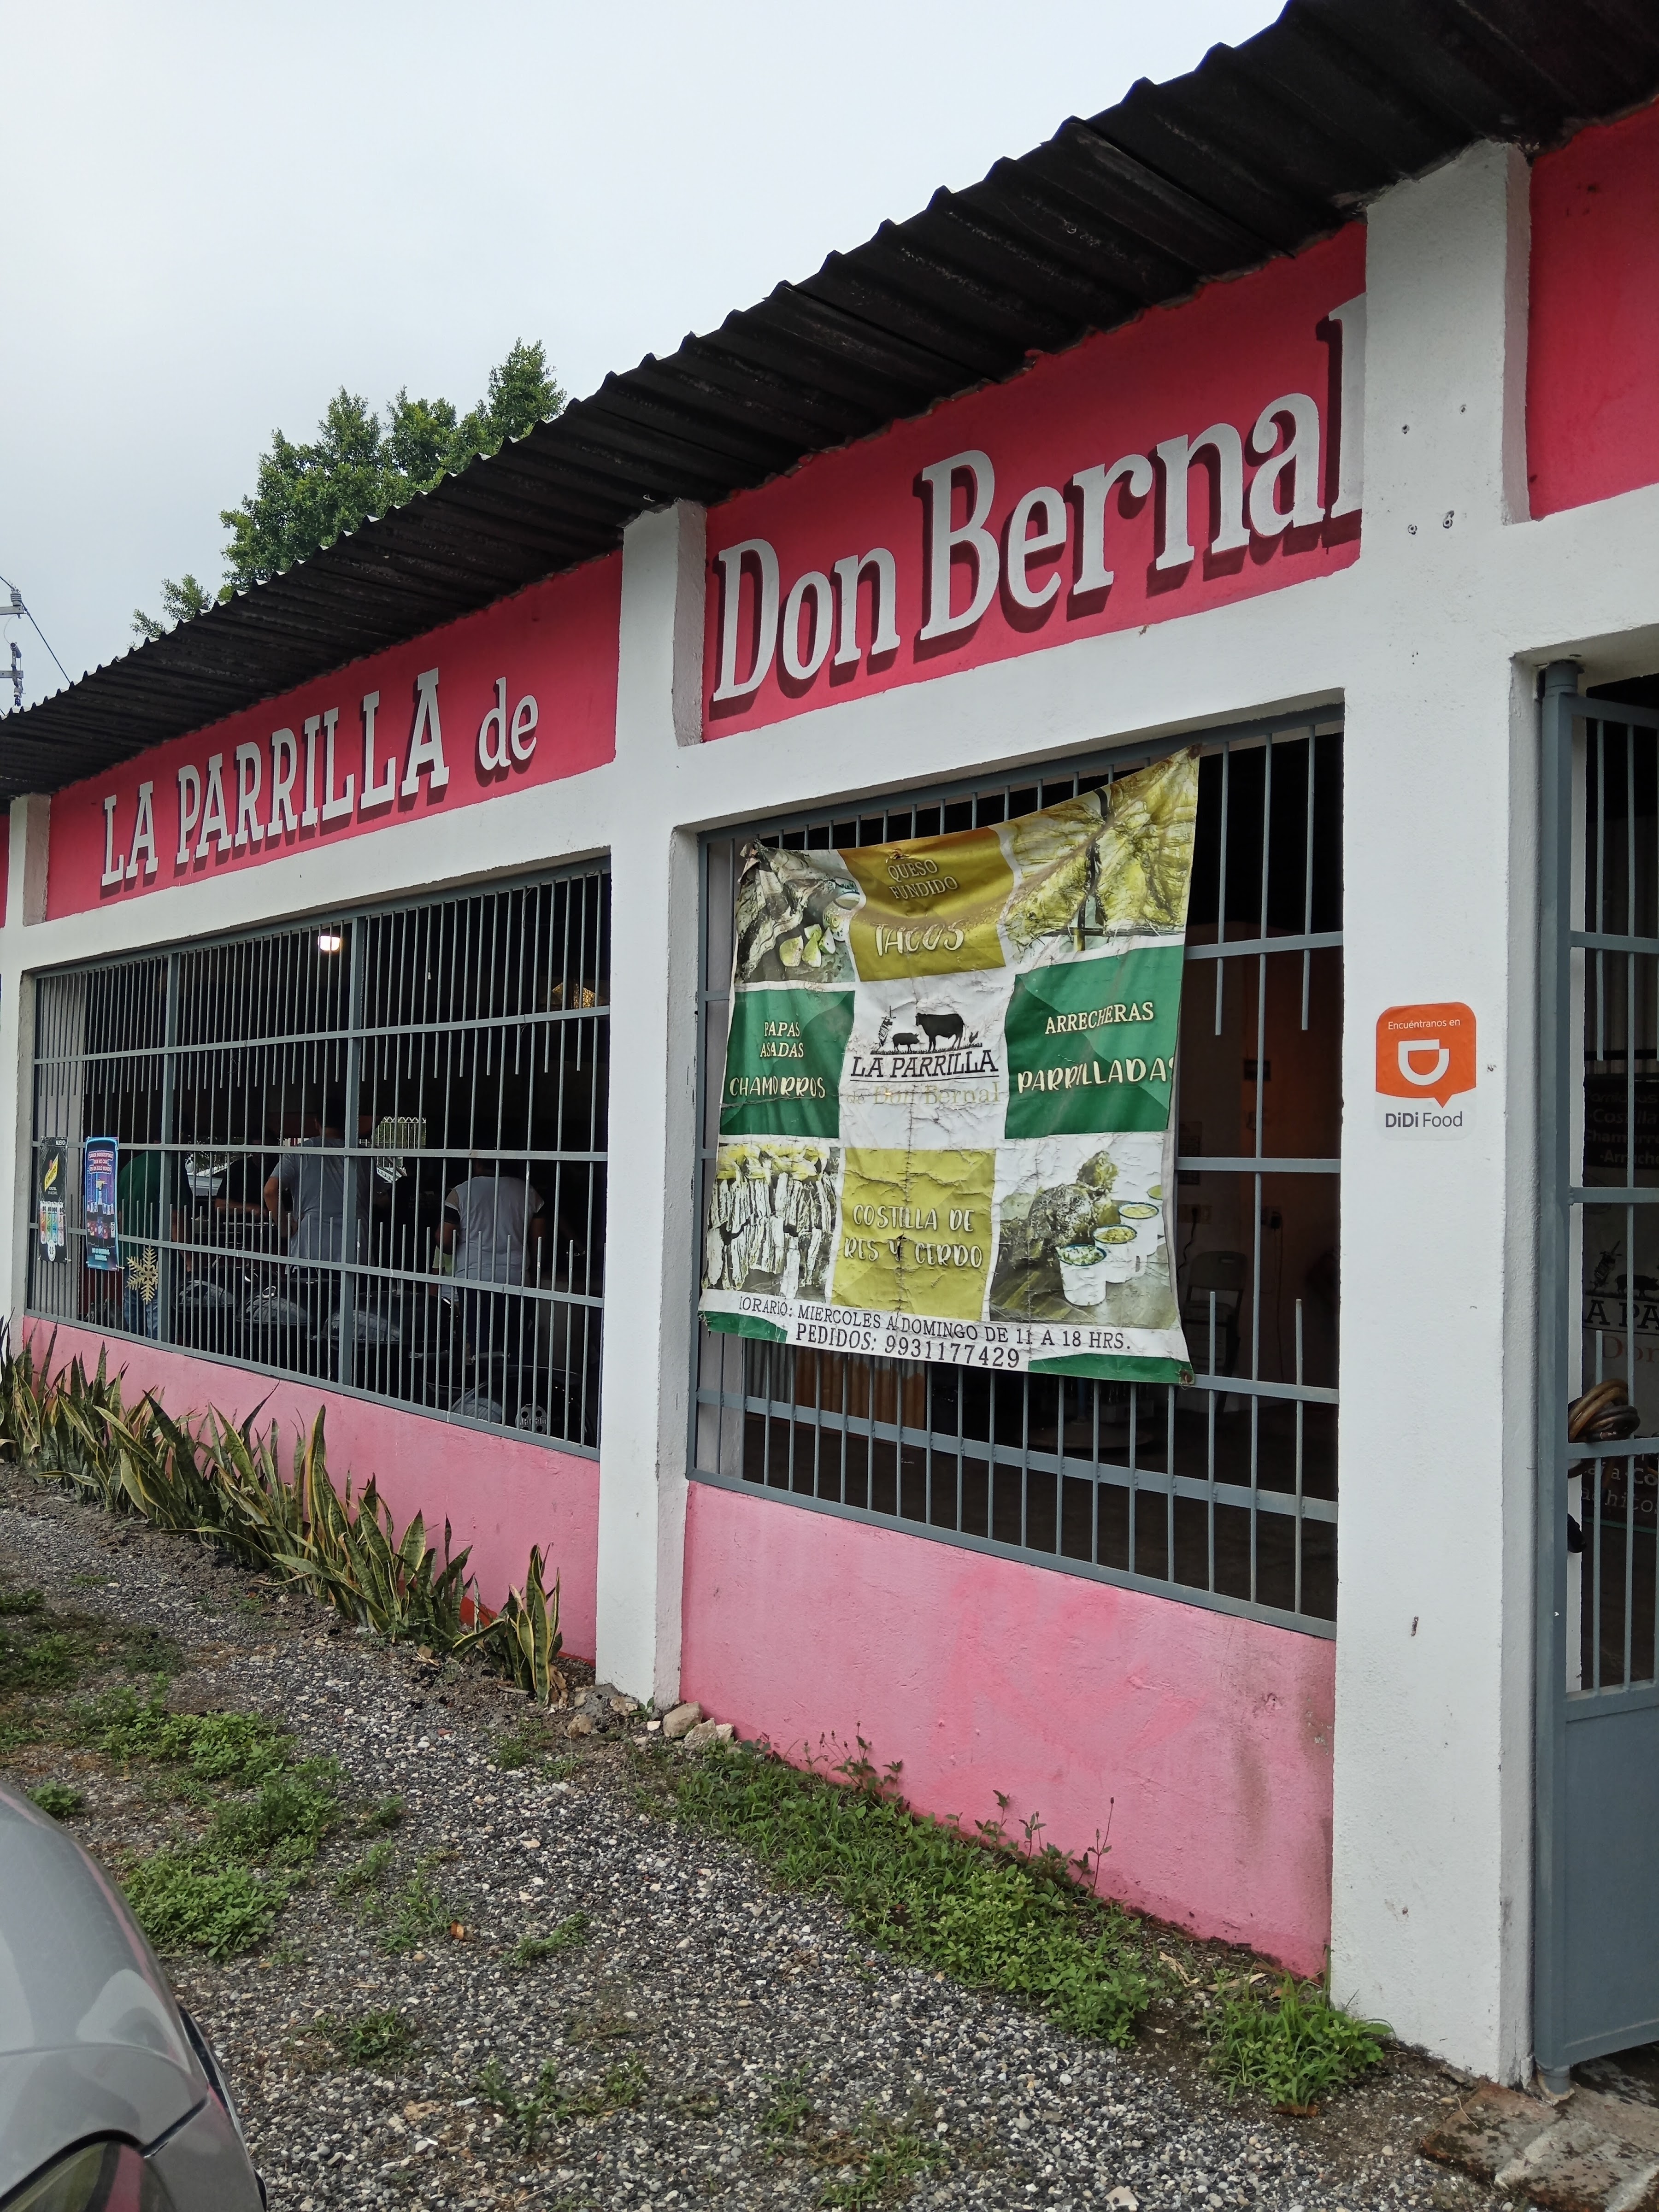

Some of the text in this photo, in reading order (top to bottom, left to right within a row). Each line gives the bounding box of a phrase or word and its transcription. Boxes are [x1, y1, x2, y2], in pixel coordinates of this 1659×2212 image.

[713, 292, 1367, 702] Don Bernal
[101, 667, 539, 887] LA PARRILLA de
[888, 859, 938, 883] QUESO
[889, 876, 959, 900] FUNDIDO
[872, 921, 965, 957] TACOS
[764, 1021, 800, 1037] PAPAS
[1045, 1001, 1154, 1035] ARRECHERAS
[1388, 1020, 1447, 1030] Encuéntranos
[759, 1041, 804, 1058] ASADAS
[851, 1049, 999, 1078] LA PARRILLA
[729, 1075, 825, 1099] CHAMORROS
[847, 1081, 1001, 1105] de Don Bernal
[1385, 1111, 1463, 1128] DiDi Food
[853, 1204, 974, 1232] COSTILLA DE
[844, 1237, 983, 1268] RES Y CERDO
[798, 1304, 881, 1329] MIERCOLES
[886, 1316, 896, 1331] A
[901, 1317, 977, 1341] DOMINGO
[985, 1326, 1008, 1343] DE
[1017, 1329, 1032, 1345] 11
[1041, 1330, 1055, 1346] A
[1063, 1330, 1081, 1347] 18
[1088, 1331, 1131, 1350] HRS.
[796, 1323, 1020, 1368] PEDIDOS: 9931177429
